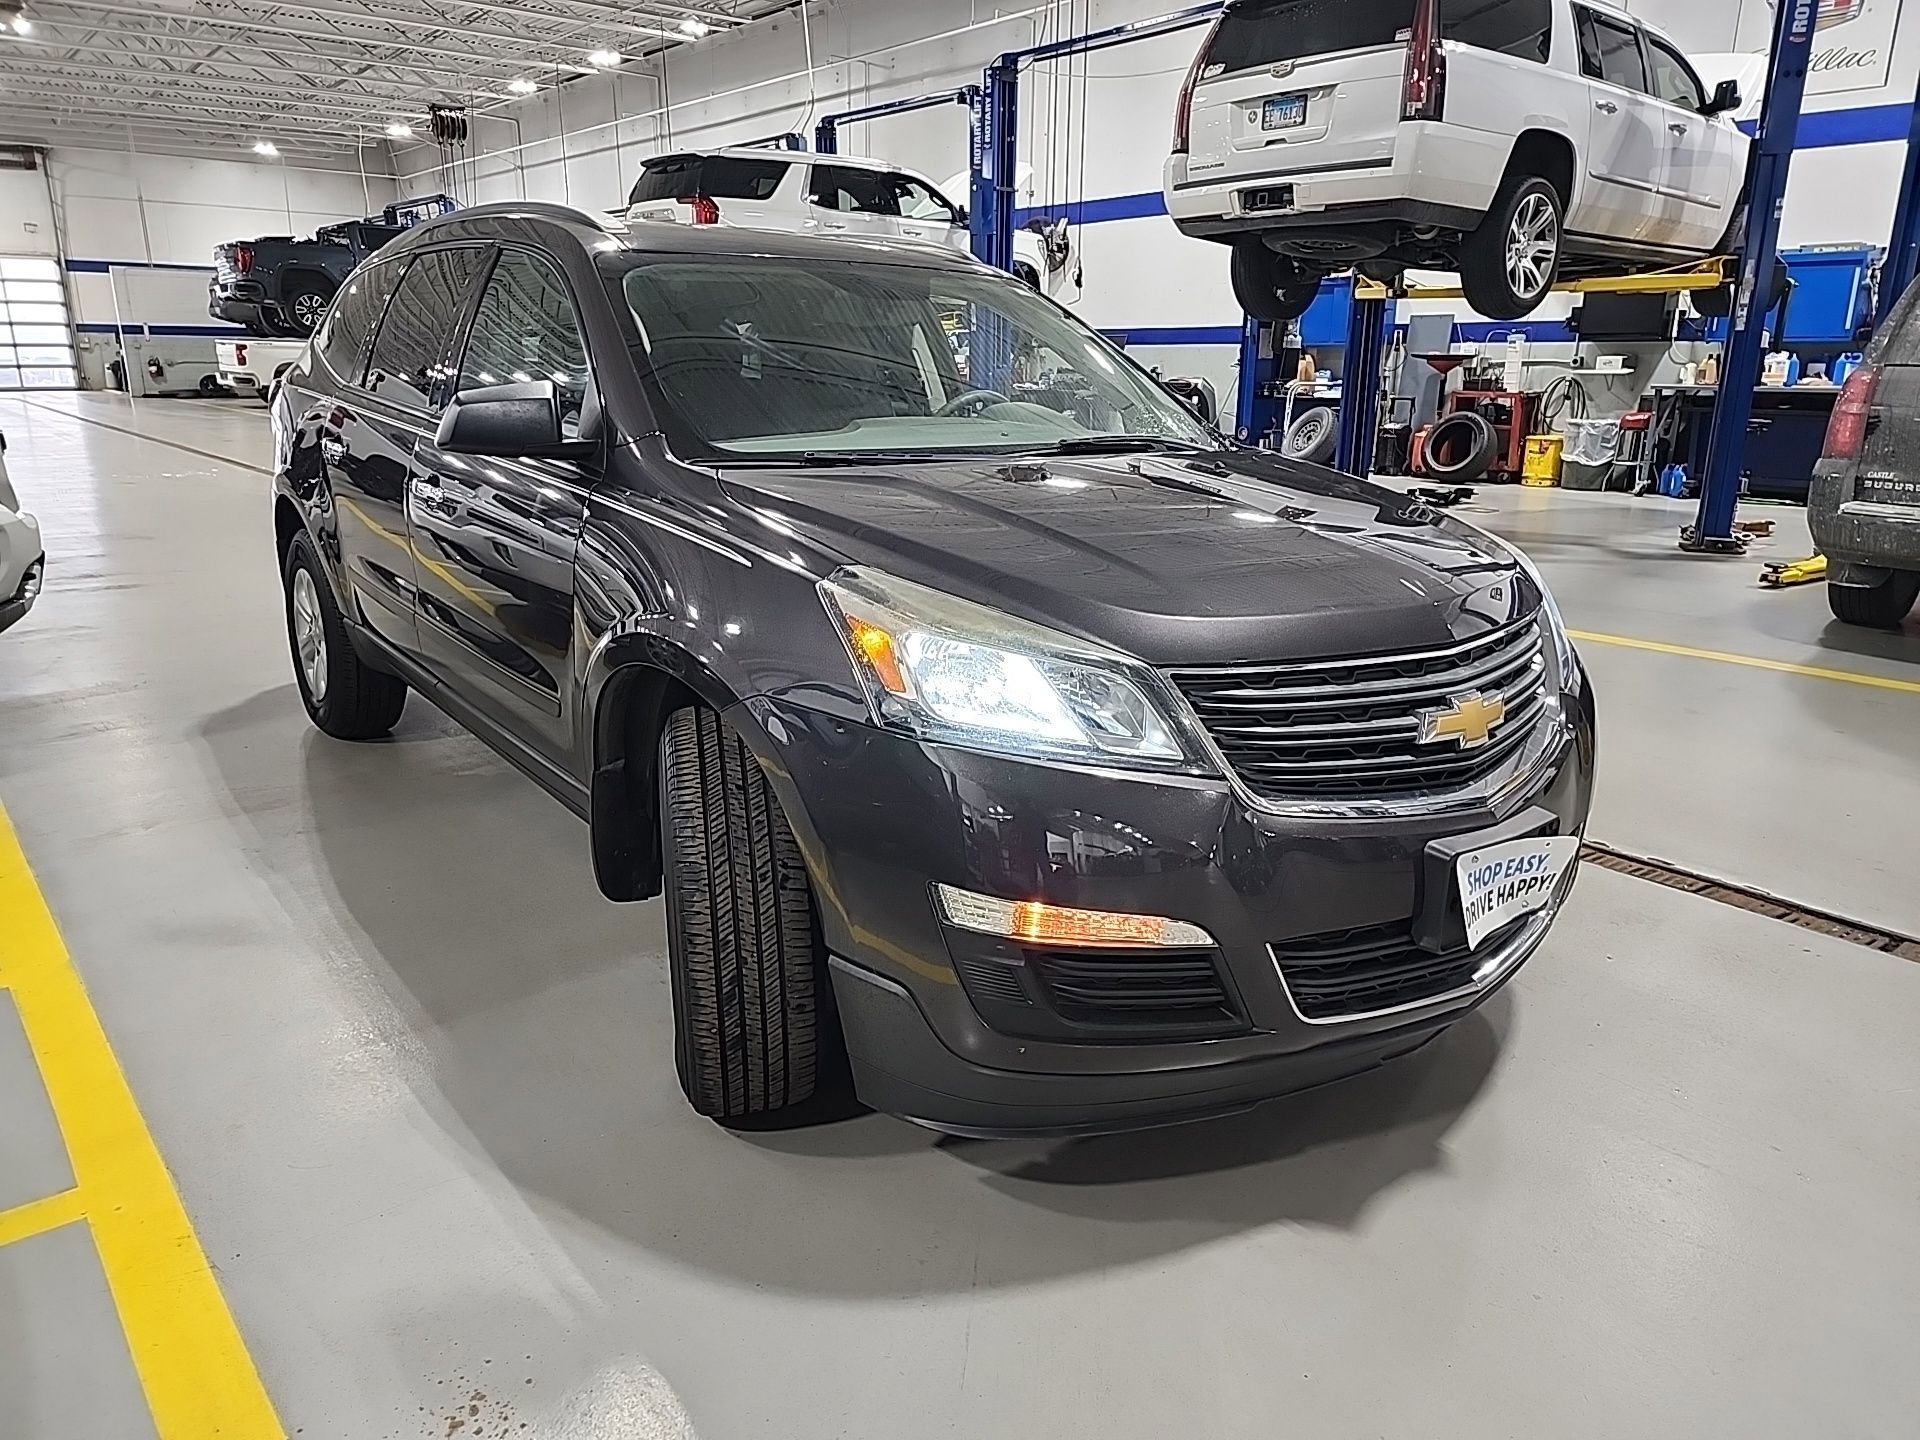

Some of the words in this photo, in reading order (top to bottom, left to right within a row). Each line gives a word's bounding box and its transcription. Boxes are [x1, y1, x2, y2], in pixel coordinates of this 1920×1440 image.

[973, 95, 982, 118] LIFT
[984, 97, 992, 143] ROTARY
[973, 121, 982, 165] ROTARY
[1867, 471, 1896, 480] CASTLE
[1467, 861, 1503, 896] SHOP
[1503, 853, 1551, 879] EASY,
[1465, 888, 1494, 930] DRIVE
[1496, 872, 1557, 908] HAPPY!
